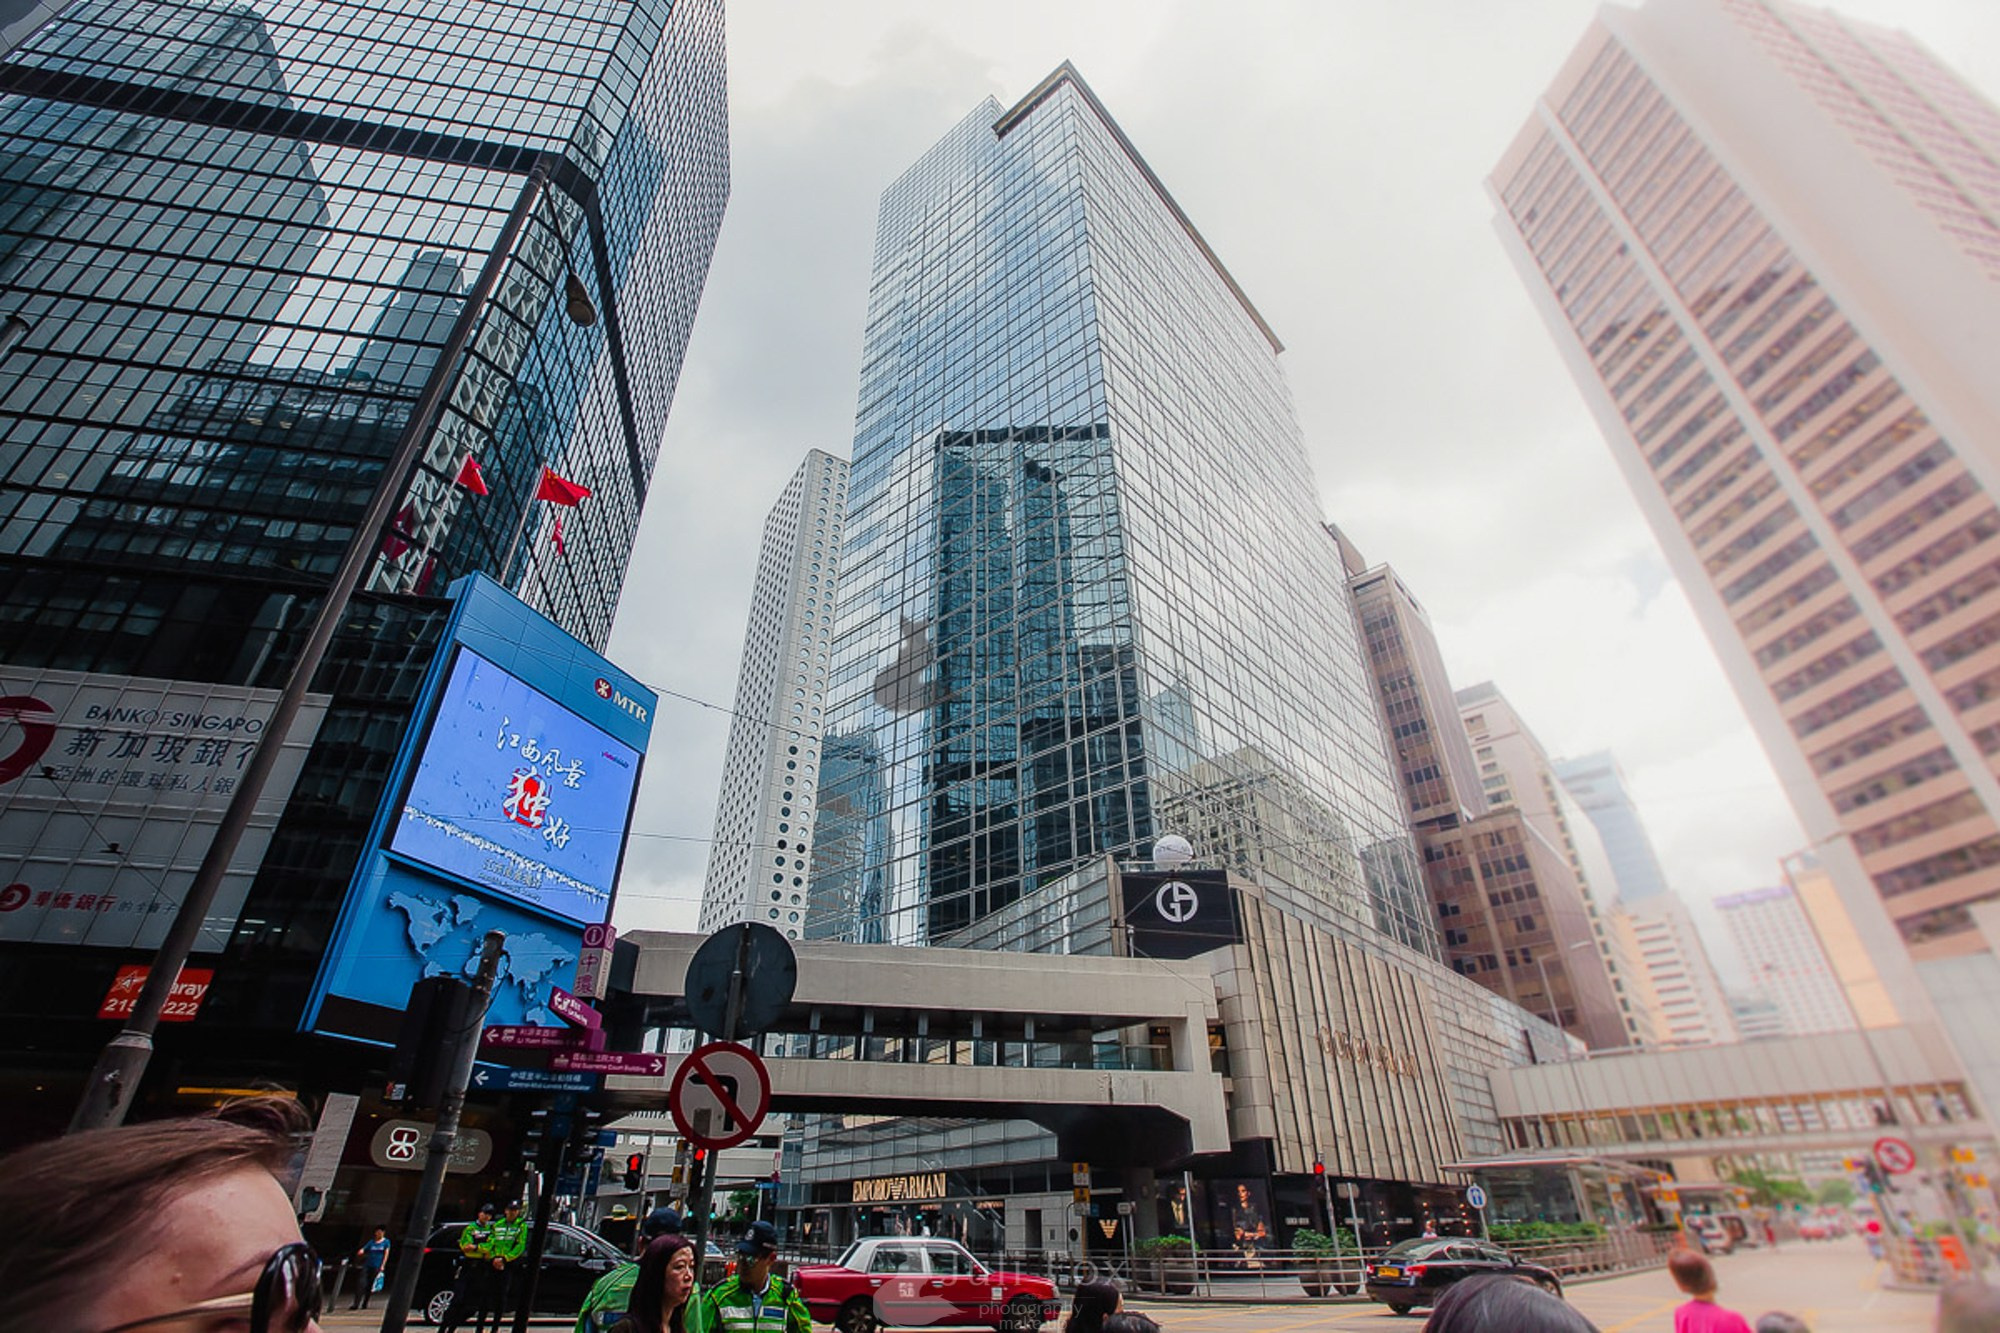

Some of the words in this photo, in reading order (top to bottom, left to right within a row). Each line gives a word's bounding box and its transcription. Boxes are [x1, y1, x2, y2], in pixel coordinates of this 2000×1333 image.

[612, 690, 648, 723] MTR
[55, 763, 236, 795] 亞洲的環球私人銀
[853, 1178, 891, 1202] EMPORIO
[901, 1172, 946, 1200] ARMANI
